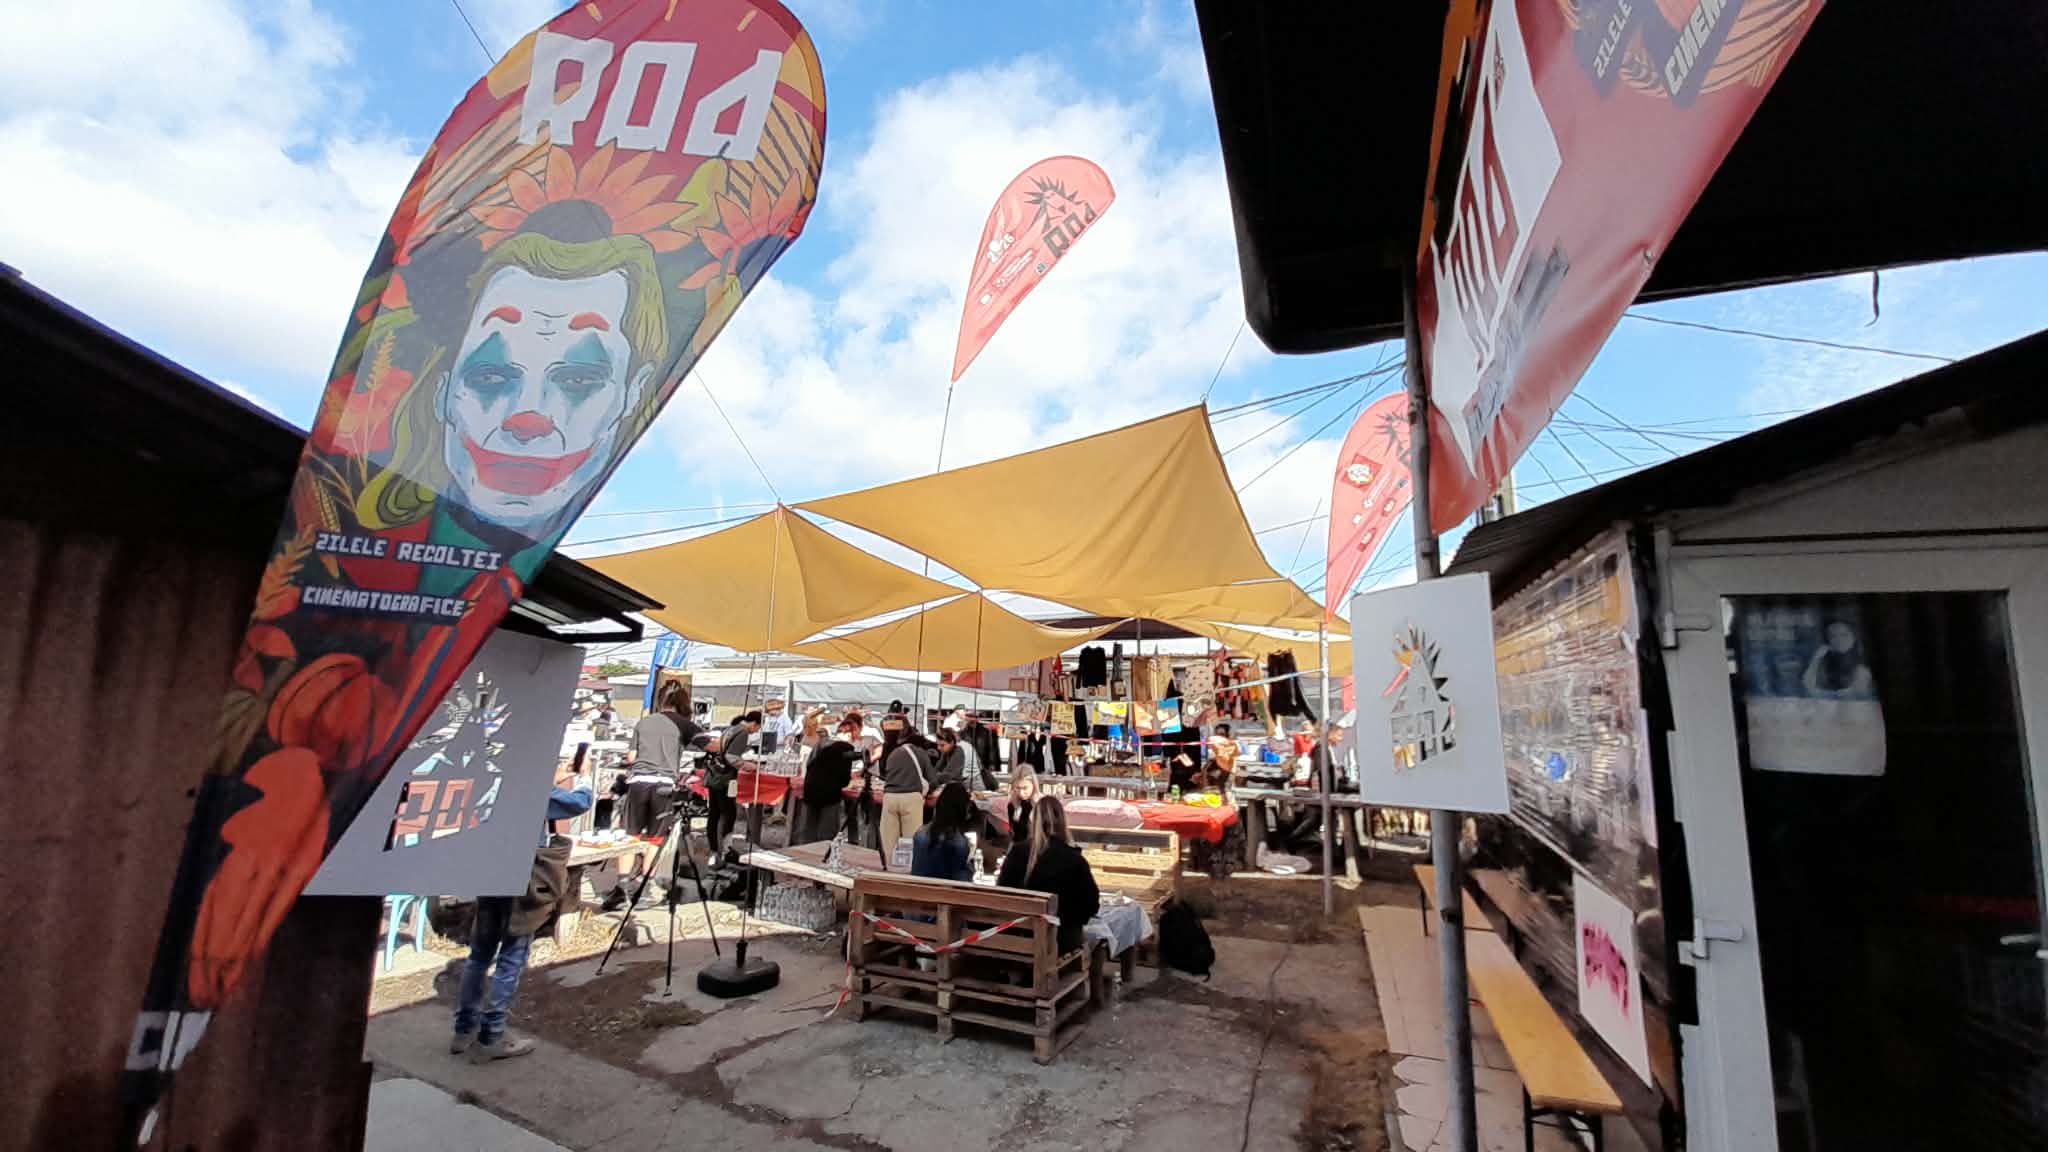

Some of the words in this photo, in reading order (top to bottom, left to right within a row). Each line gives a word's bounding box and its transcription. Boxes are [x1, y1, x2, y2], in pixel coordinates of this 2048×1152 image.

[518, 31, 783, 162] ROA
[315, 533, 388, 557] ZILELE
[397, 542, 501, 570] RECOLTEI
[303, 586, 465, 616] CINEMATOGRAFICE
